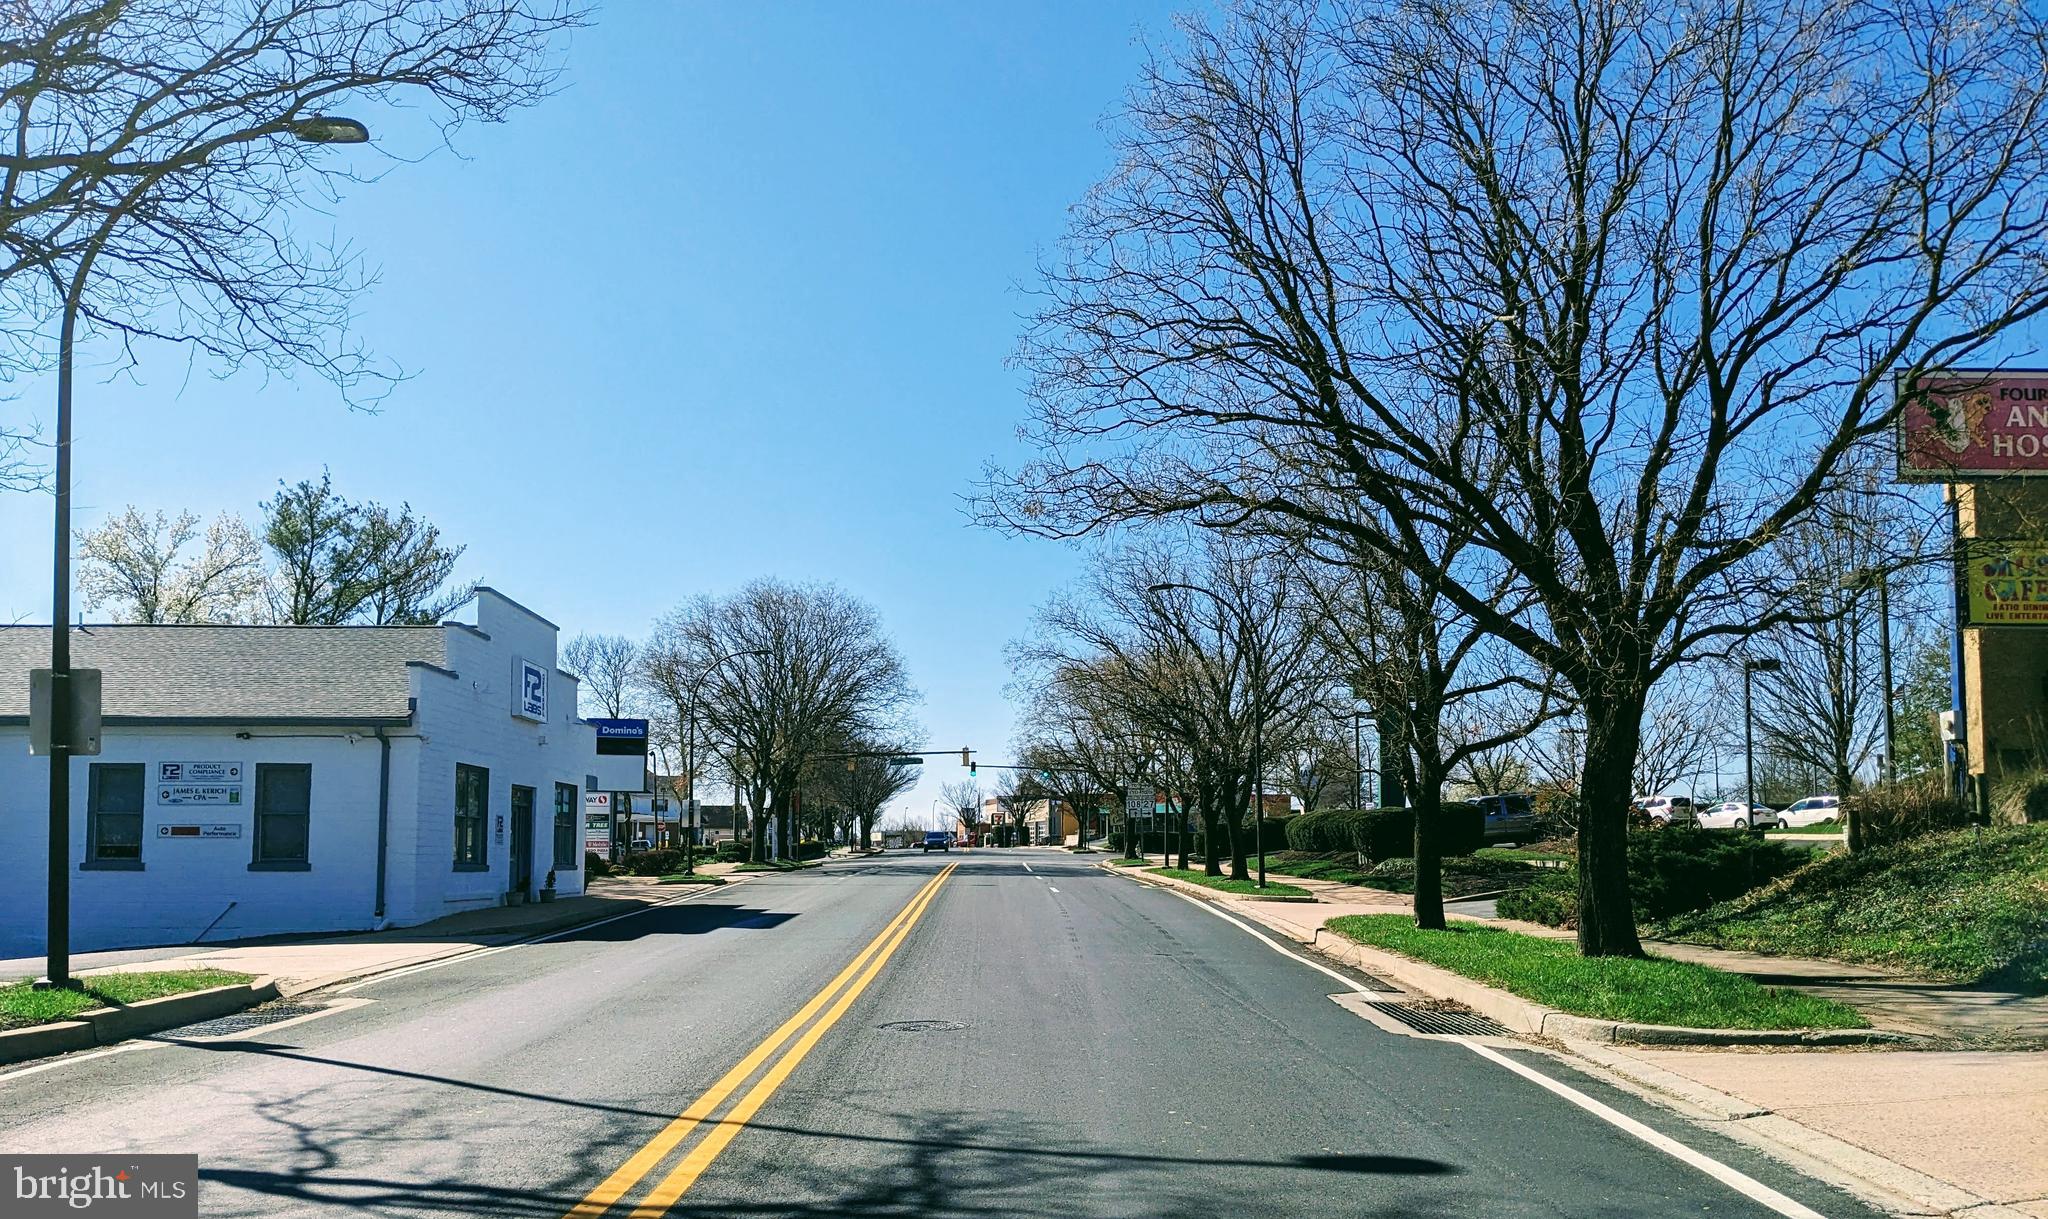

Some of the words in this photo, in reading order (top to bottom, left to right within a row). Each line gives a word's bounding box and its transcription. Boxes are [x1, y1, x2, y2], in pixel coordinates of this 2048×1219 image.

[2000, 388, 2048, 401] FOUR
[524, 665, 542, 703] F2
[602, 726, 643, 735] Domino's
[162, 764, 180, 775] F2
[1128, 800, 1141, 808] 108
[1143, 800, 1154, 808] 27
